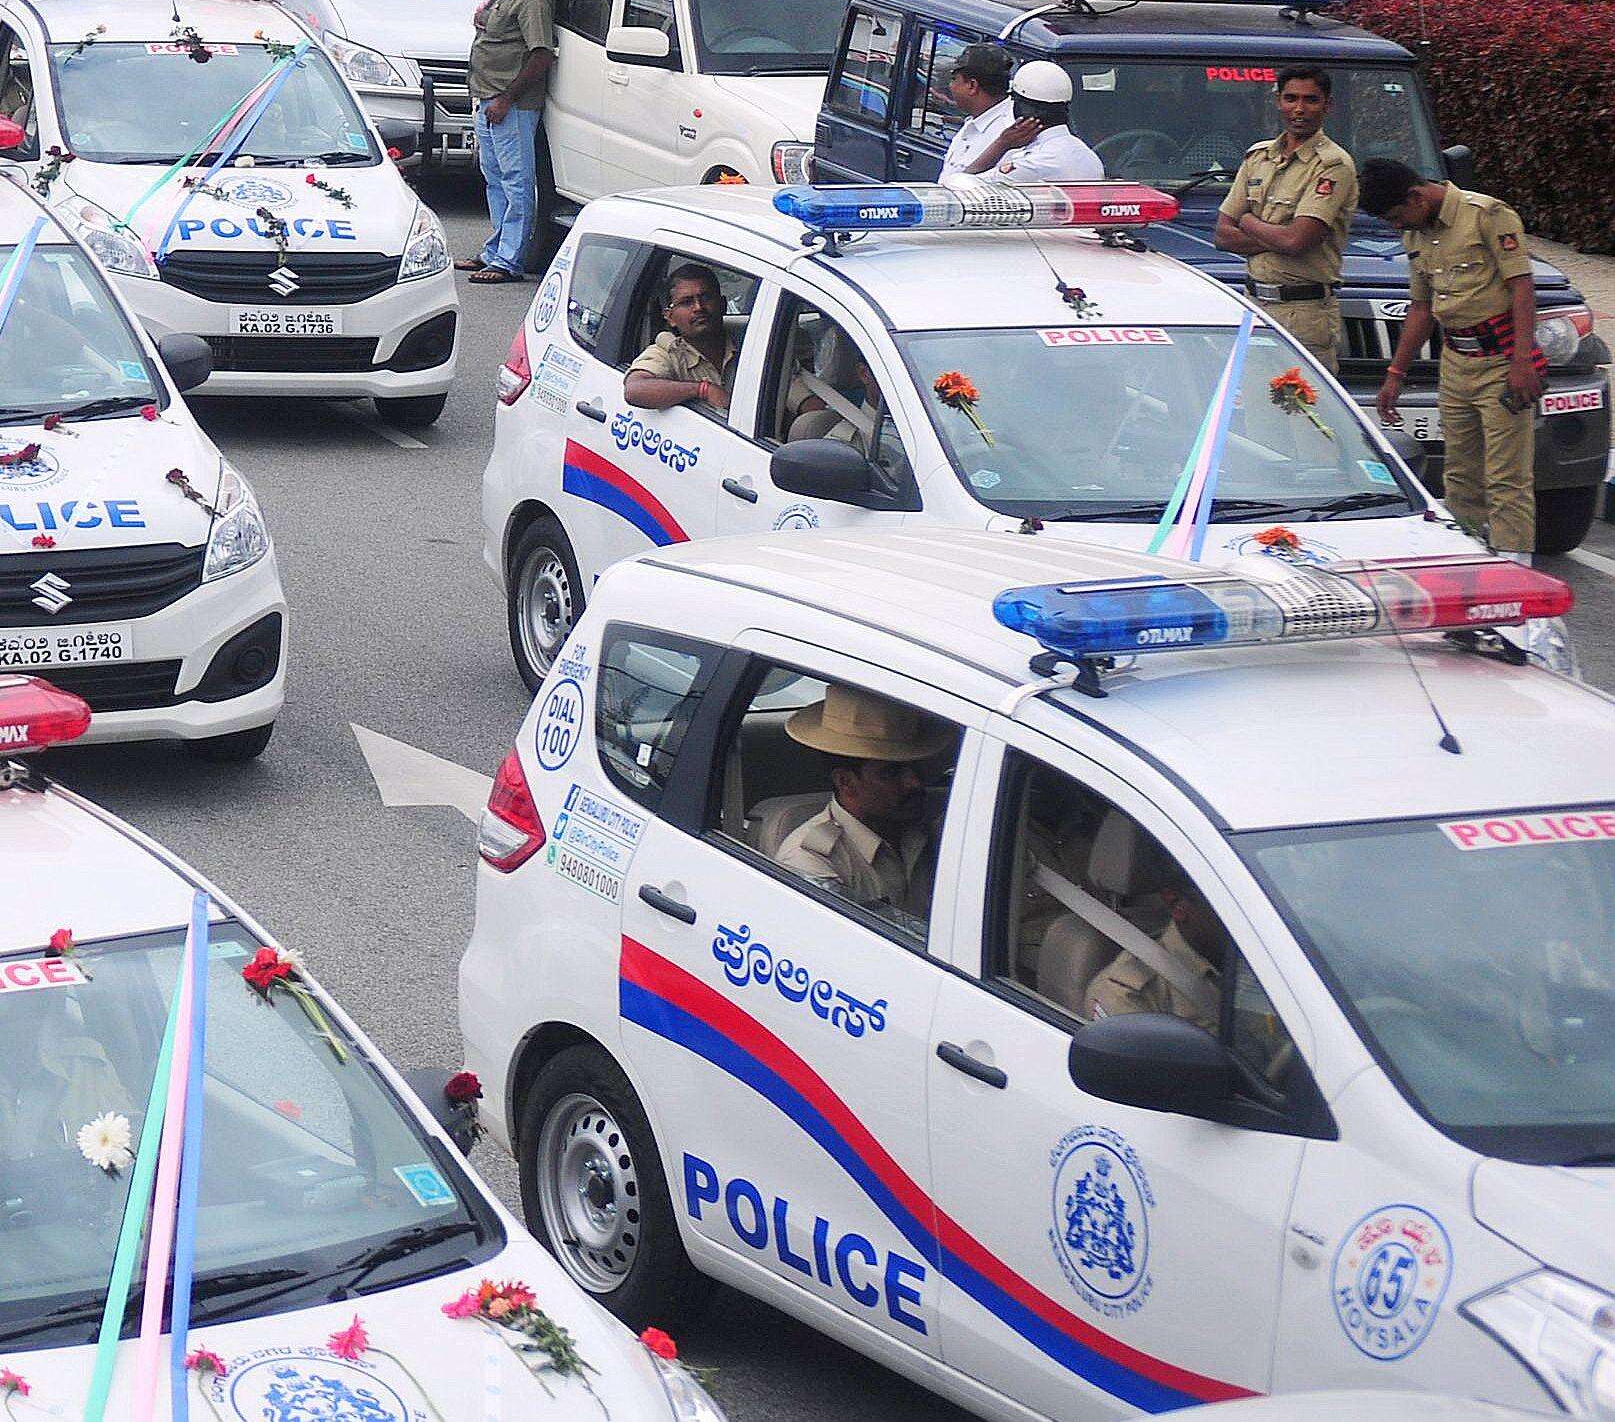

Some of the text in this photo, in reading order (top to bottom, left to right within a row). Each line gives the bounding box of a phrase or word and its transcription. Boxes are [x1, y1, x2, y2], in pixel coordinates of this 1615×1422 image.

[151, 44, 234, 54] POCE
[1206, 67, 1276, 81] POLICE
[860, 207, 899, 219] OTLMAX
[1101, 205, 1141, 217] OTLMAX
[239, 323, 333, 334] KA.02 G.1736
[1046, 330, 1167, 344] POLICE
[1544, 393, 1599, 412] POLICE
[610, 410, 701, 473] ಪೊಲೀಸ್
[1467, 602, 1524, 621] OTLMAX
[1137, 625, 1193, 645] OTLMAX
[59, 646, 121, 662] G.1740
[549, 694, 575, 723] DIAL
[542, 723, 570, 756] 100
[1451, 816, 1615, 847] POLICE
[560, 853, 619, 899] 9480801000
[711, 923, 888, 1038] ಪೊಲೀಸ್
[684, 1151, 929, 1337] POLICE
[1366, 1251, 1413, 1309] 65
[1338, 1286, 1432, 1350] HOYSALA
